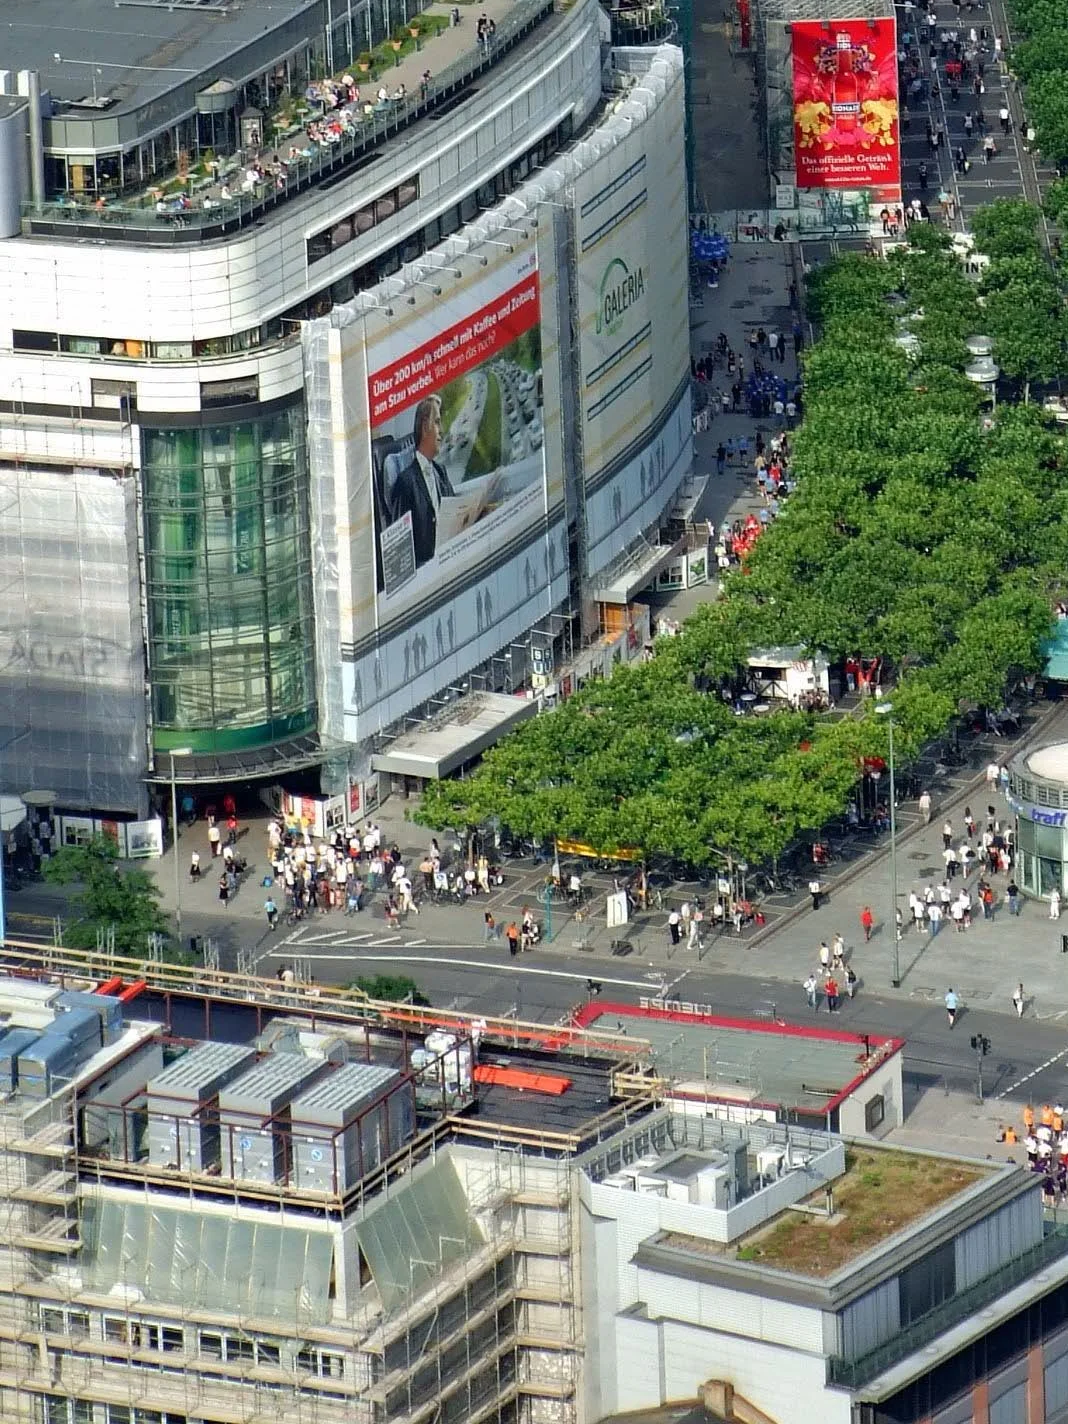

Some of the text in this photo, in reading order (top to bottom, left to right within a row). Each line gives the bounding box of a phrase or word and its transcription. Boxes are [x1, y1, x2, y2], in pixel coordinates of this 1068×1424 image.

[604, 267, 645, 325] GALERIA
[373, 286, 536, 397] Über 200 km/h schnell mit Kaffee und Zeitung
[374, 330, 498, 416] am Stau vorbei. Wer kann das noch?
